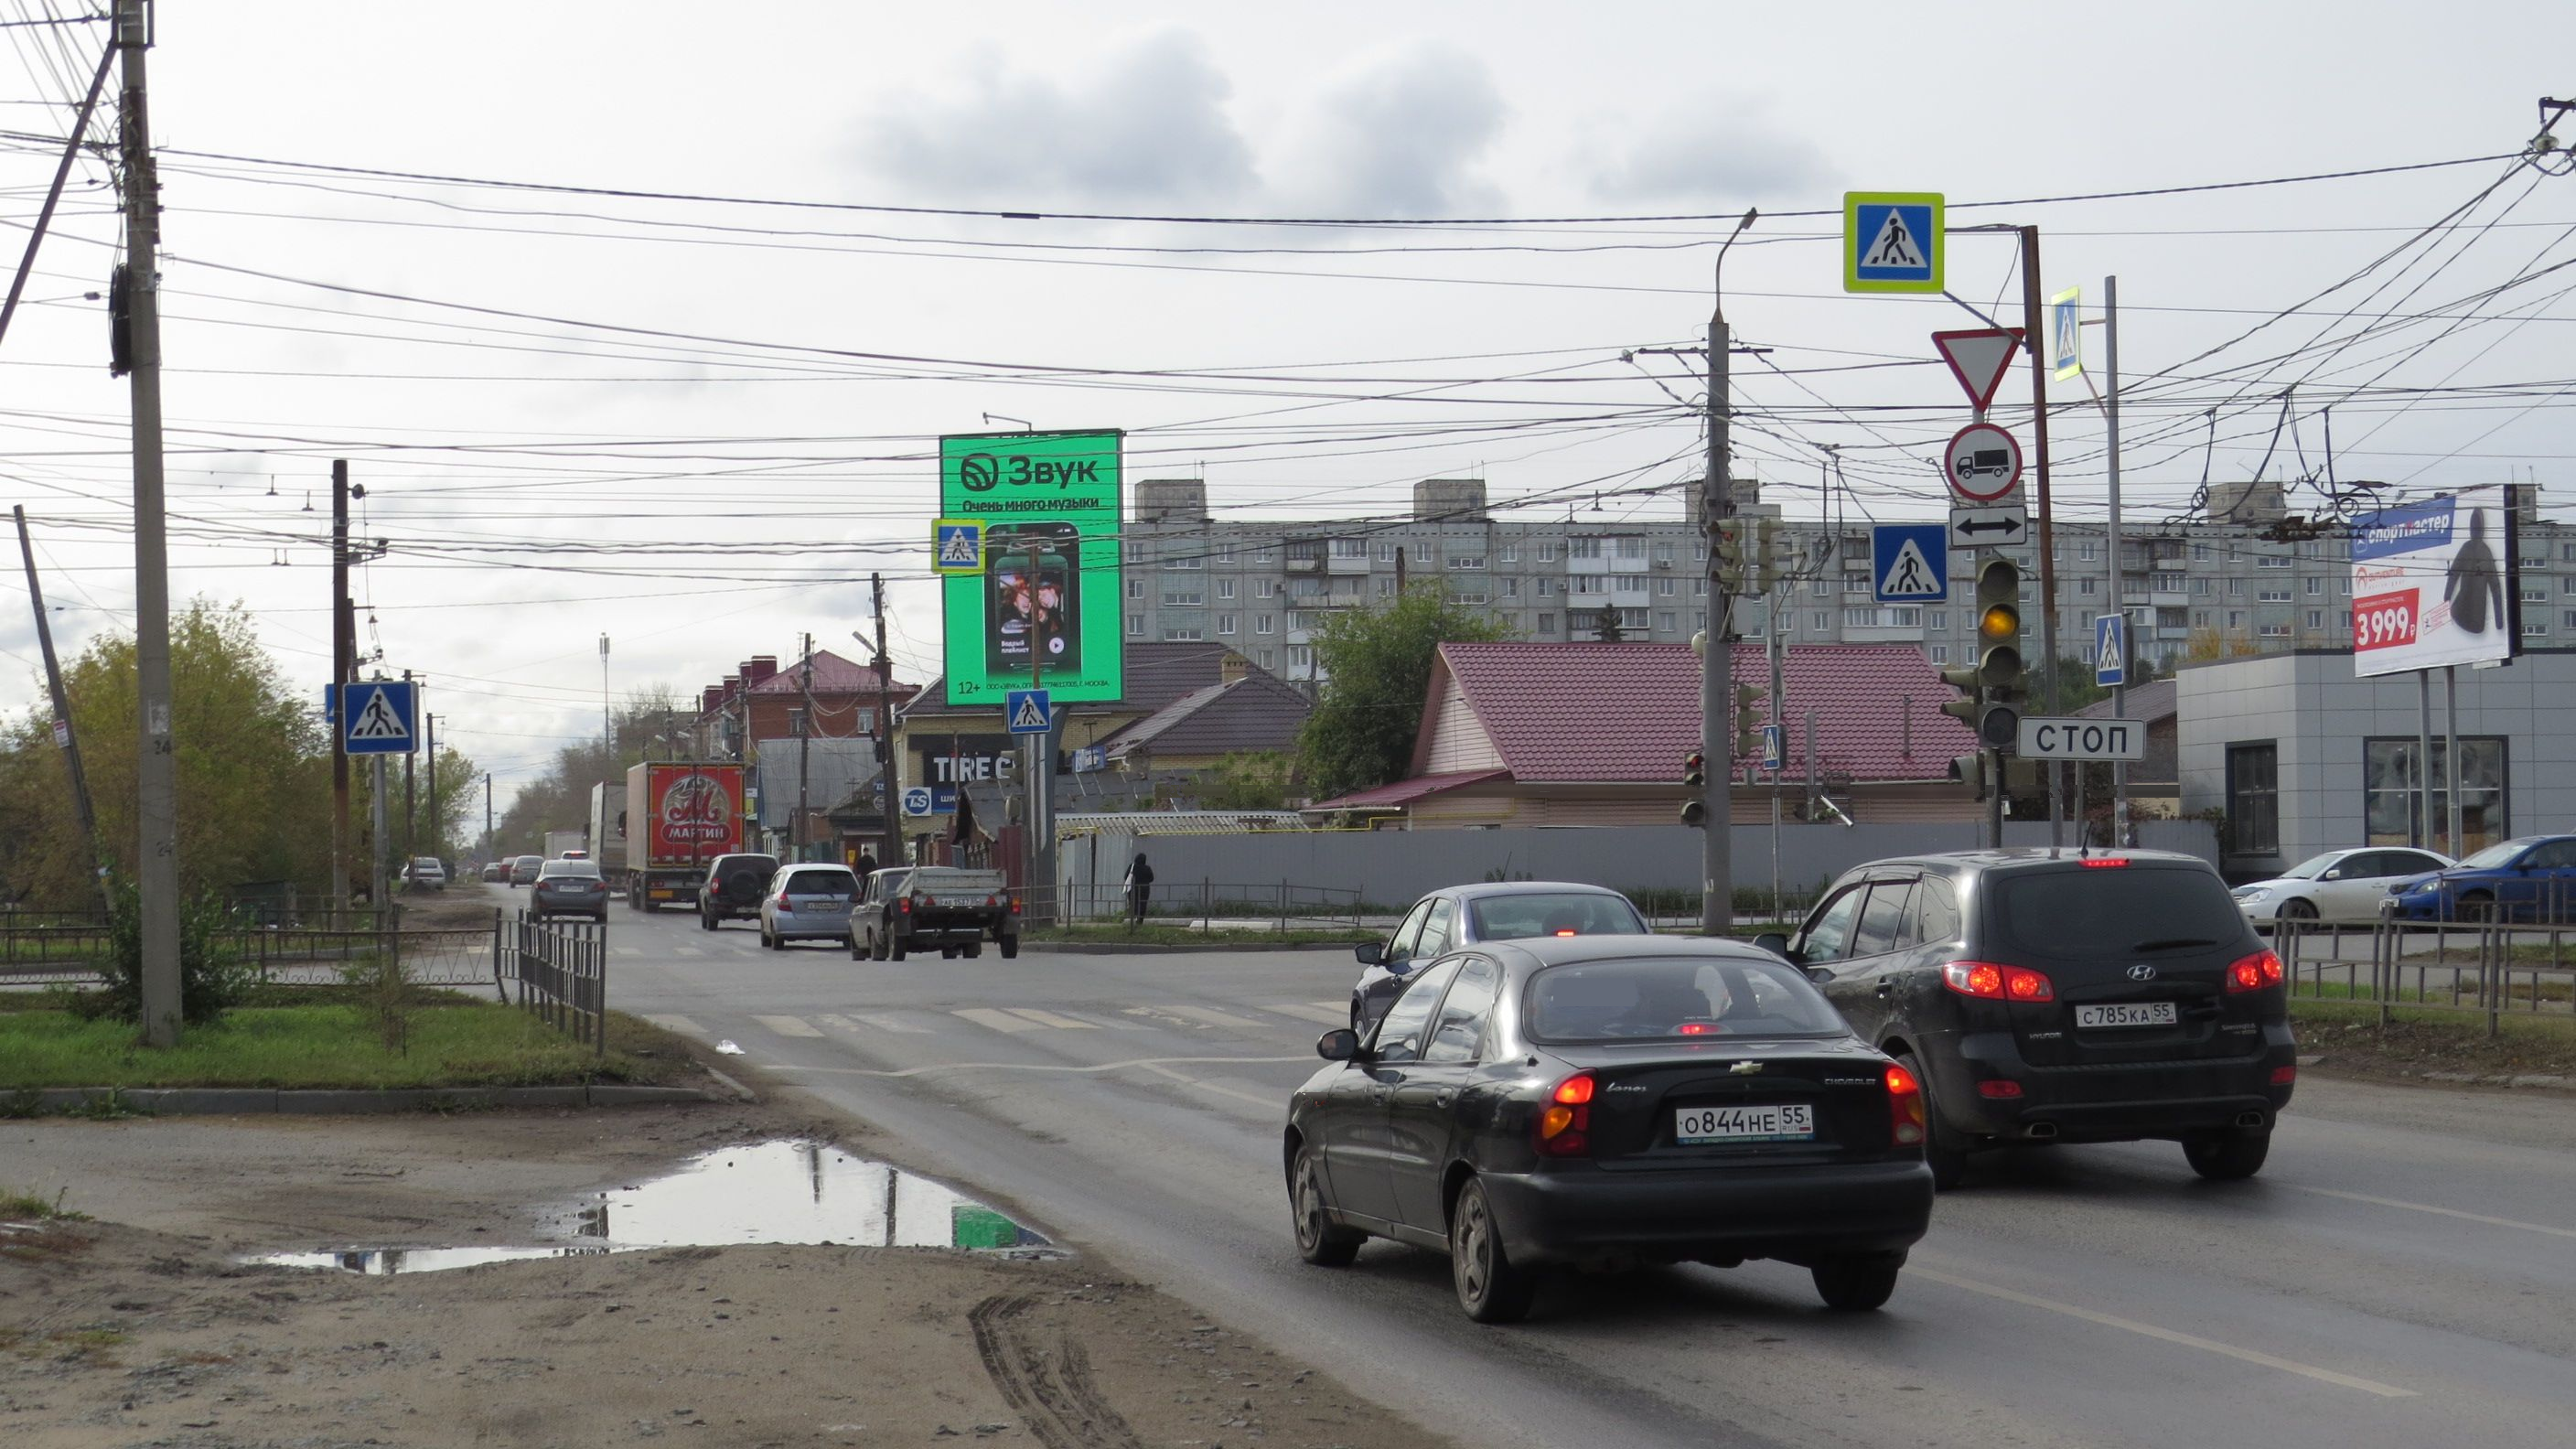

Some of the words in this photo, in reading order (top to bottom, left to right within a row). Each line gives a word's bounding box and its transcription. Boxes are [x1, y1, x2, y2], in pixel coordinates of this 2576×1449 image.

[1008, 456, 1100, 489] Звук
[962, 499, 1003, 512] Очень
[1005, 499, 1046, 511] много
[1047, 497, 1099, 511] музыки
[958, 682, 981, 695] 12+
[2036, 724, 2127, 753] СТОП
[933, 757, 991, 782] TIRE
[668, 827, 724, 839] МАРТИН
[2083, 1006, 2151, 1025] С785КА
[2152, 1004, 2170, 1017] 55
[1685, 1110, 1776, 1134] О844НЕ
[1782, 1107, 1805, 1124] 55
